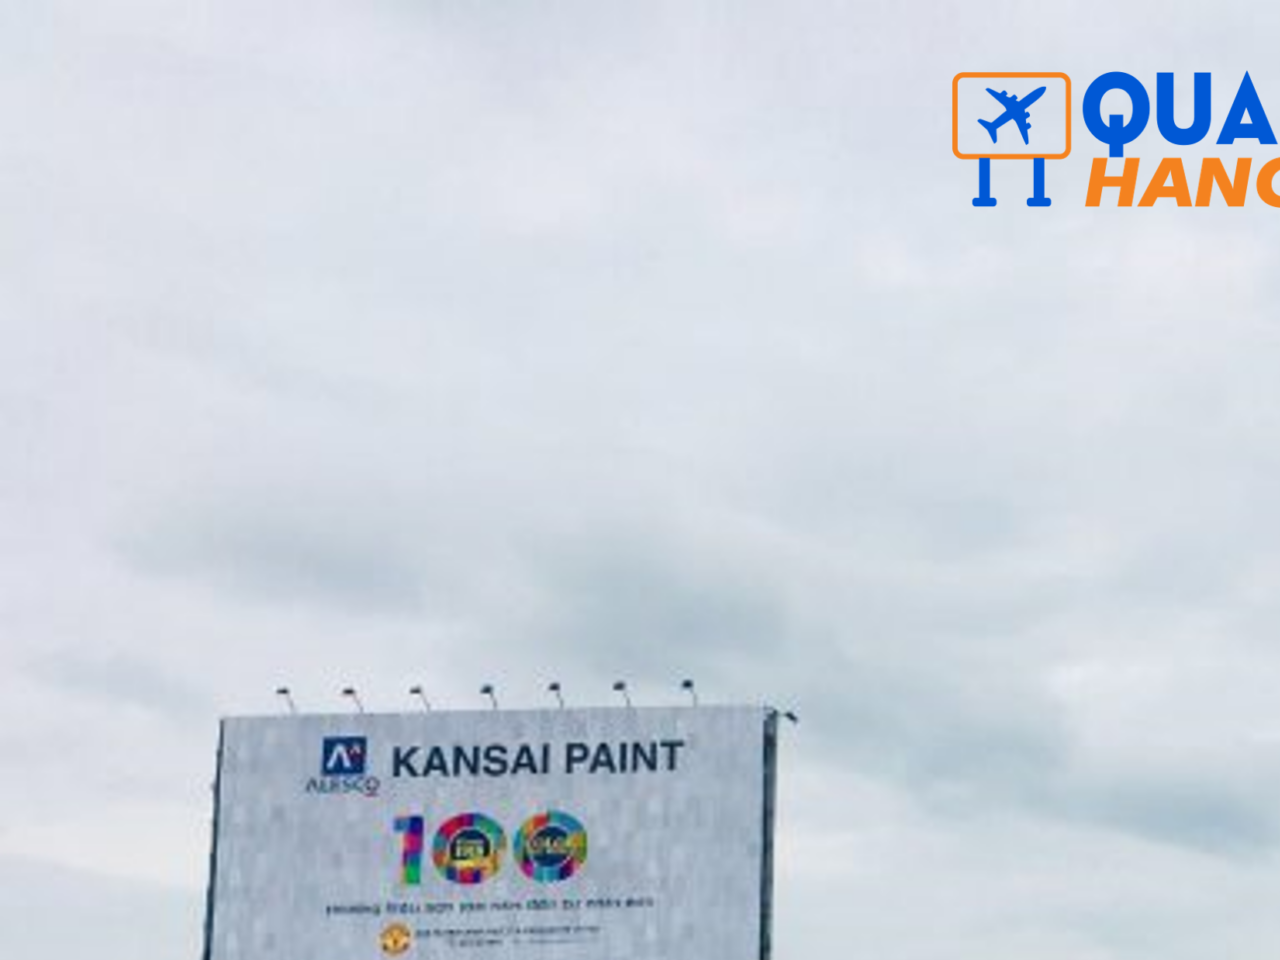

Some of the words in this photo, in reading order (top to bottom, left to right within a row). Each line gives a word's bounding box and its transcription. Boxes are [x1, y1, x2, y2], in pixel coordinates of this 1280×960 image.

[391, 744, 549, 778] KANSAI
[564, 740, 685, 775] PAINT
[393, 810, 588, 886] 100
